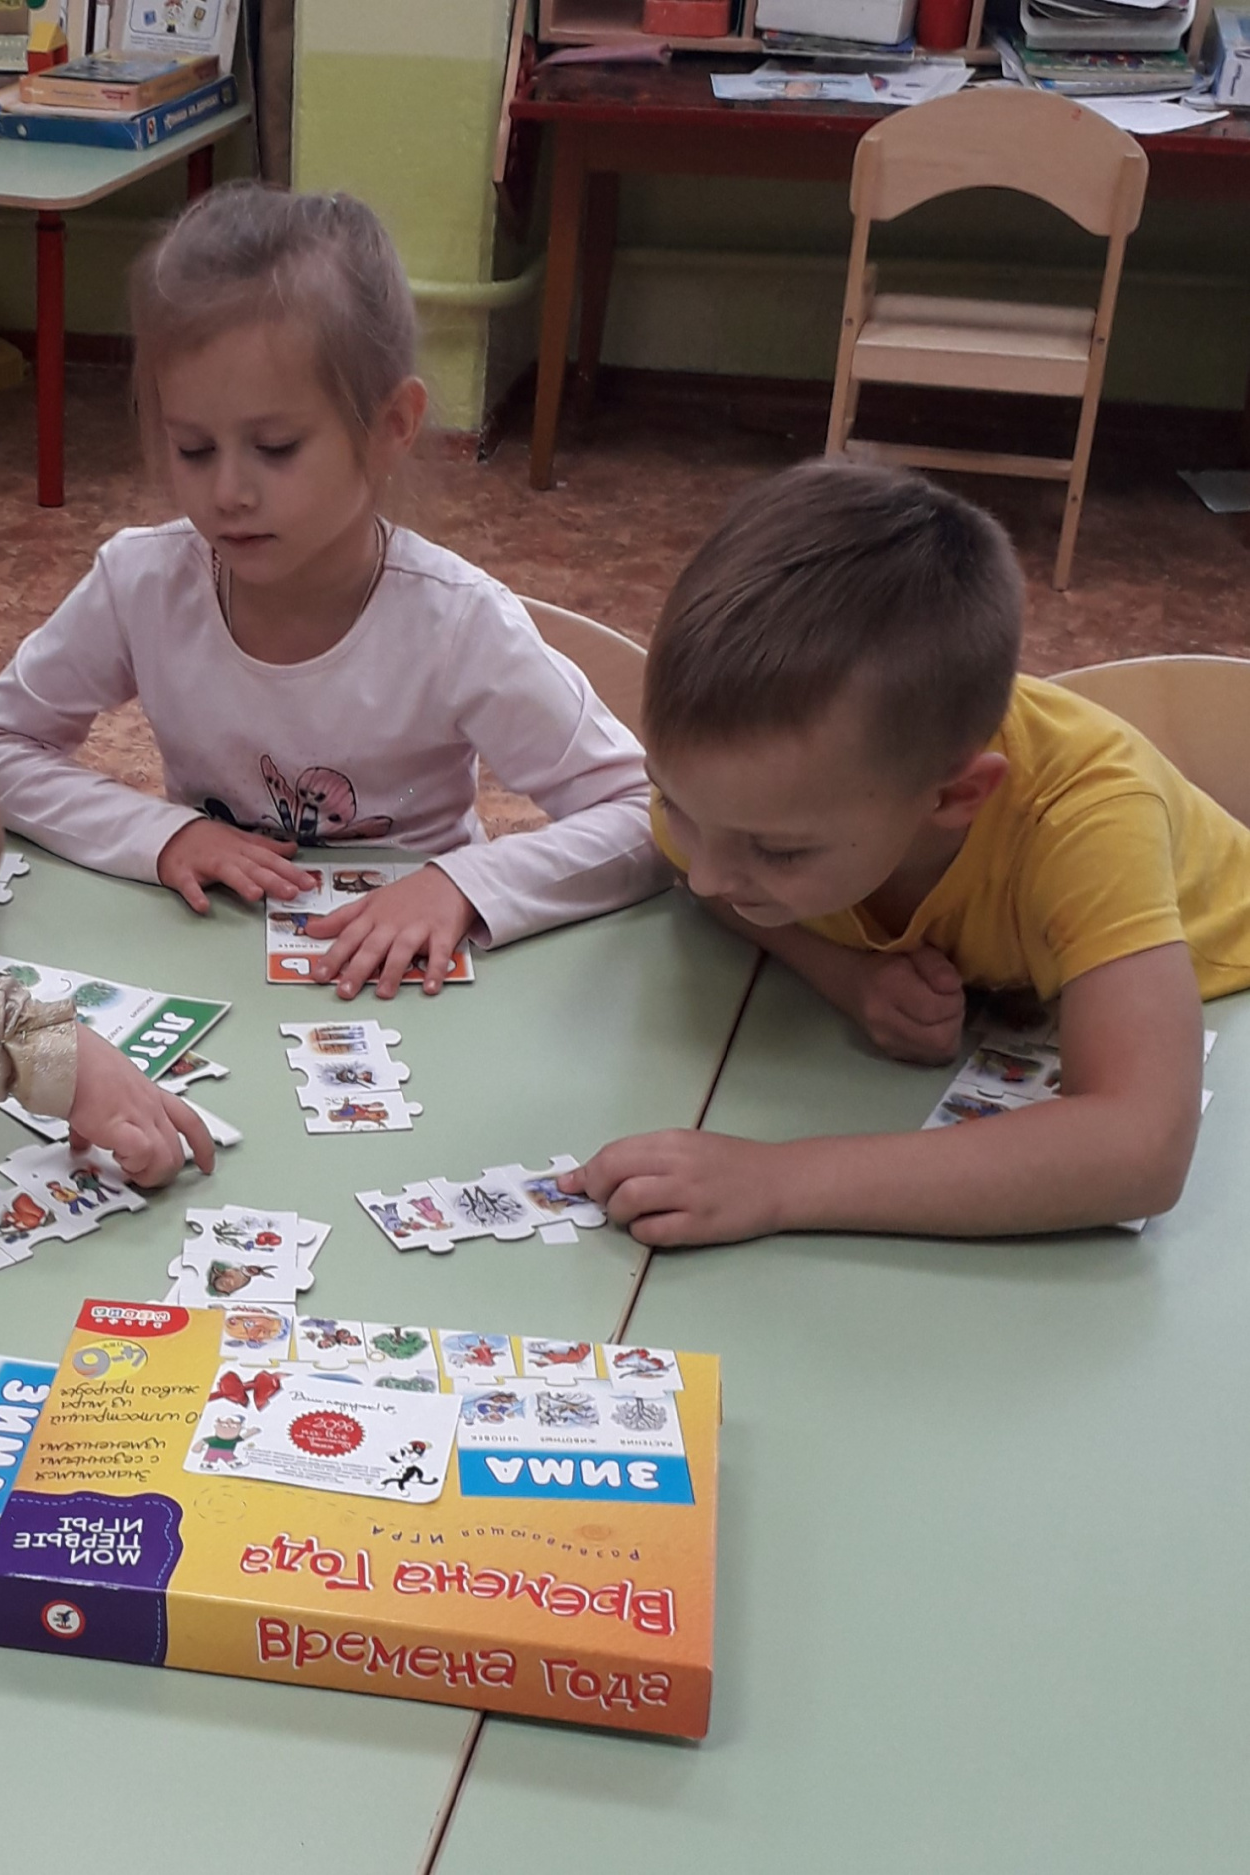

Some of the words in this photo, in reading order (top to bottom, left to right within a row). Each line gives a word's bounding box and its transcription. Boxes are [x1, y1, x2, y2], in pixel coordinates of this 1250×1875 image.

[72, 1345, 147, 1379] 4-6
[60, 1380, 135, 1400] природы
[141, 1384, 200, 1398] живой
[61, 1396, 107, 1409] мира
[111, 1397, 132, 1409] из
[50, 1407, 180, 1425] иллюстраций
[39, 1437, 166, 1452] изменениями
[40, 1452, 143, 1466] сезонными
[35, 1469, 151, 1483] Знакомимся
[484, 1456, 660, 1490] ЗИМА
[57, 1517, 144, 1533] ИГРЫ
[13, 1532, 141, 1549] ПЕРВЫЕ
[371, 1525, 445, 1545] ИГРА
[461, 1526, 641, 1561] Развивающая
[70, 1549, 141, 1566] МОИ
[239, 1532, 374, 1592] Года
[392, 1559, 677, 1637] Времена
[255, 1616, 518, 1688] Времена
